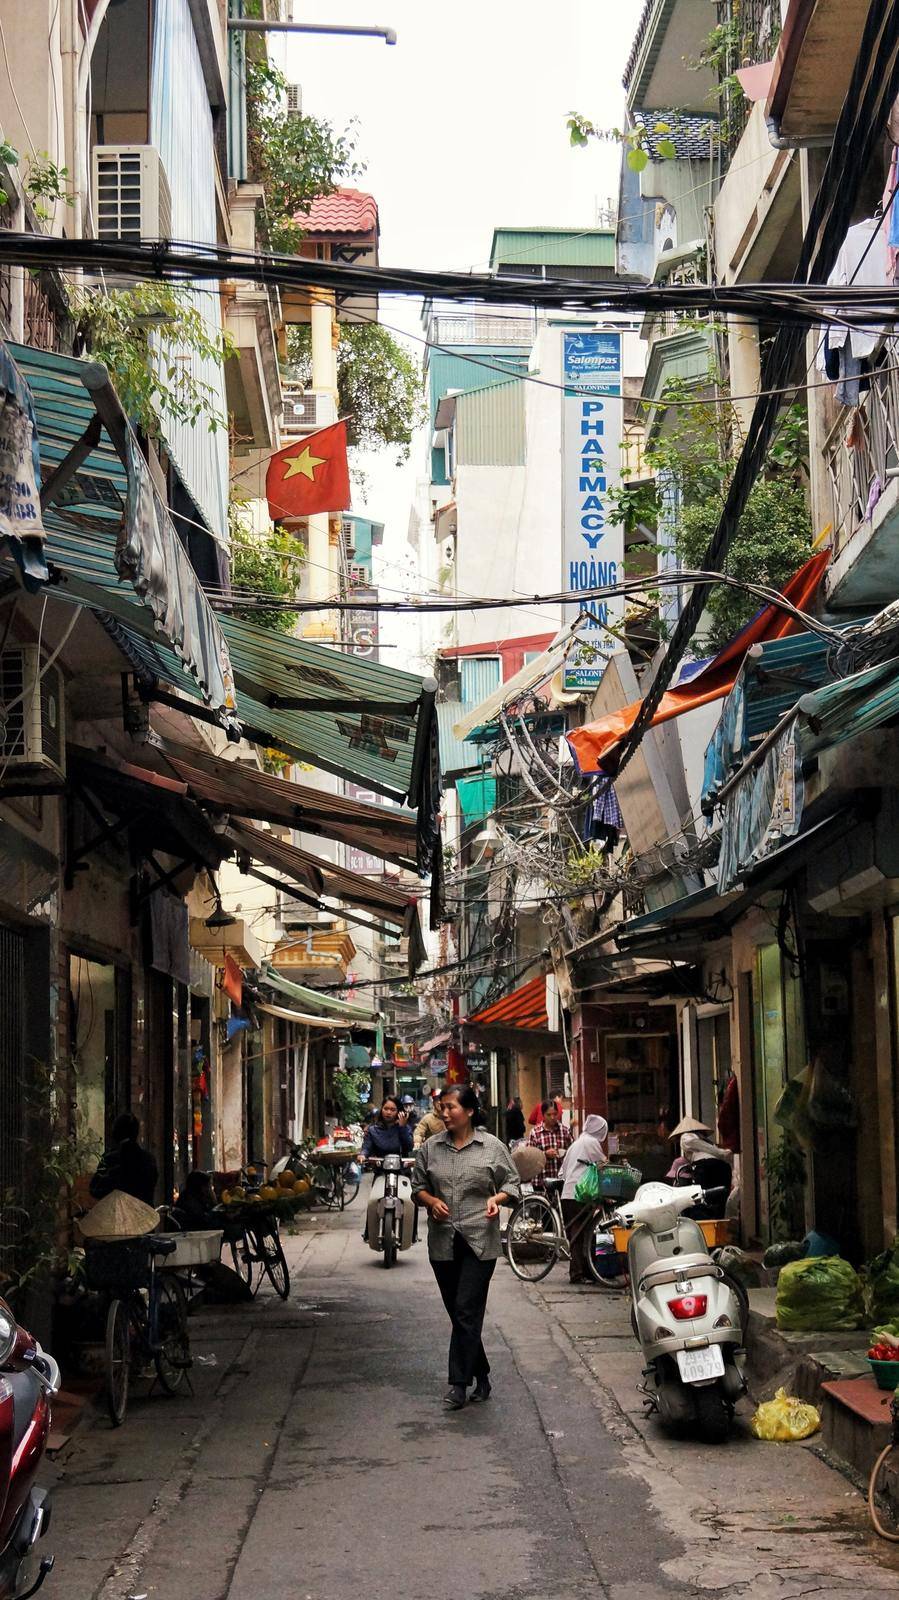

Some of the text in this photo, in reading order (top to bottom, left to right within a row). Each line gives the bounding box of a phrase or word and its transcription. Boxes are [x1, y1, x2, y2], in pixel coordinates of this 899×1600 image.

[567, 355, 618, 365] Salonpas
[579, 401, 607, 549] PHARMACY
[570, 555, 617, 590] HOÀNG
